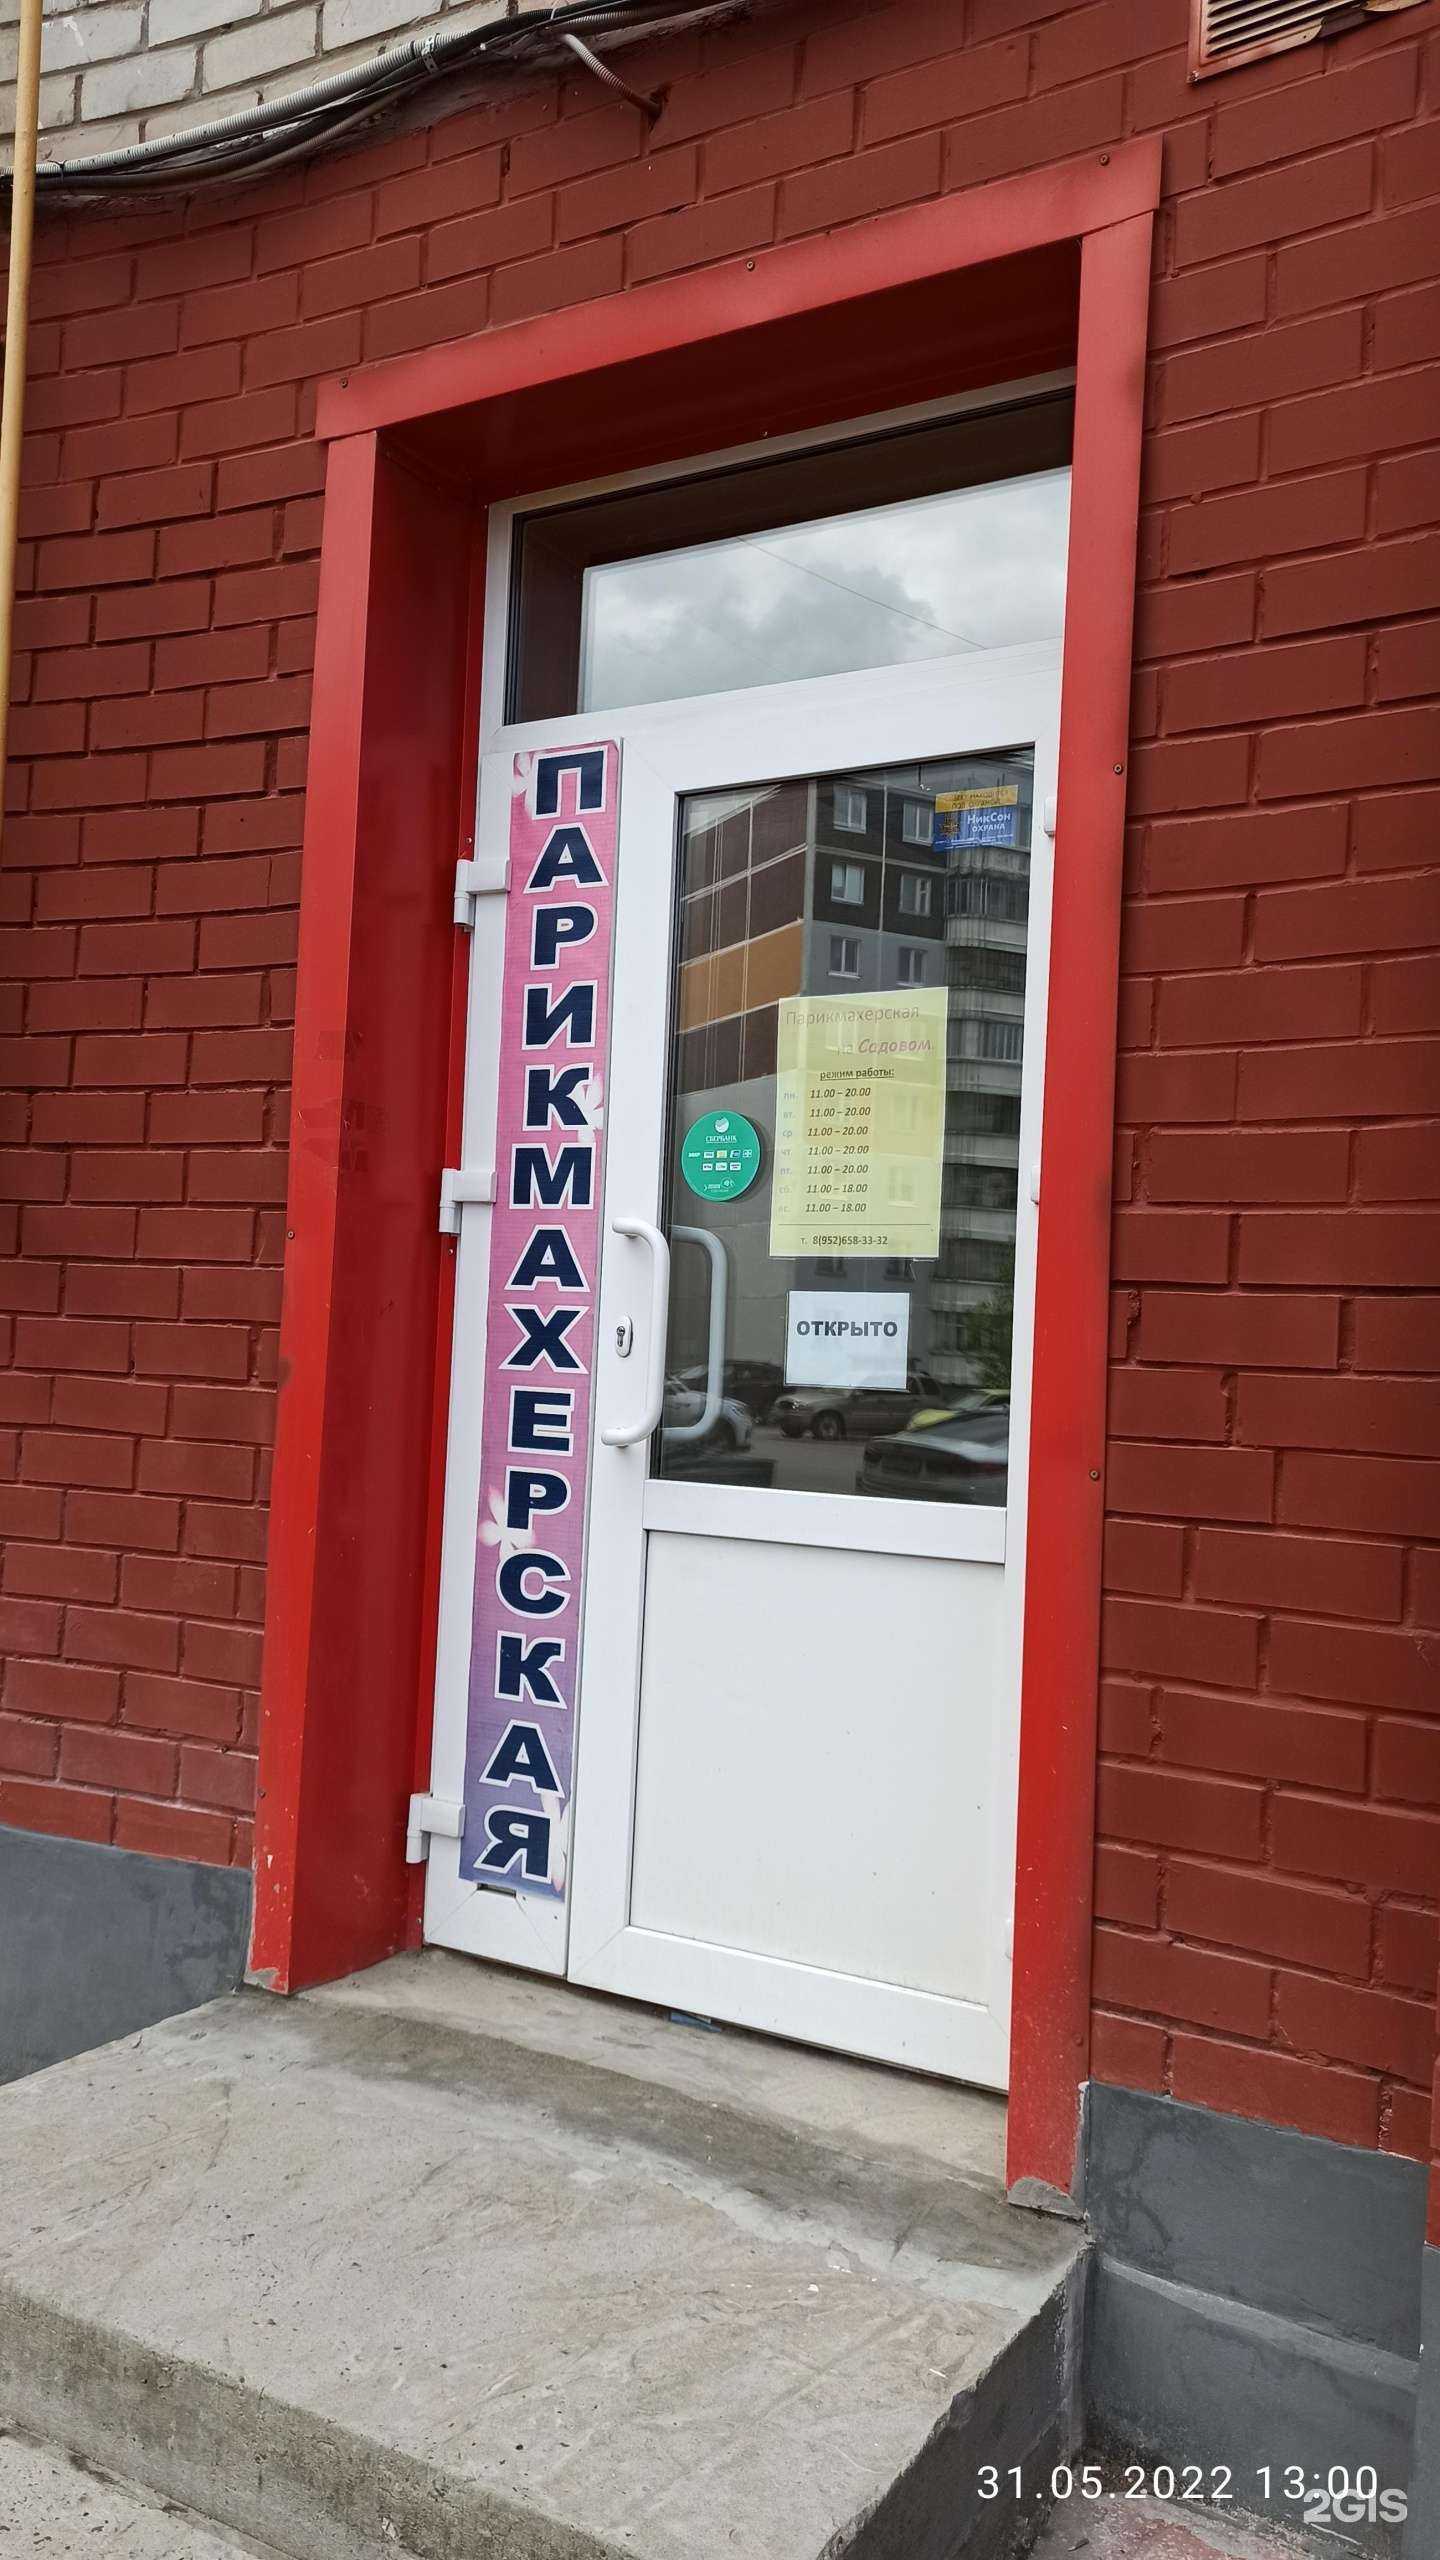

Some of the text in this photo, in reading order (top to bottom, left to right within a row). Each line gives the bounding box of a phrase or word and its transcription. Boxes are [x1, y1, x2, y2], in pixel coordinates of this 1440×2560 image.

[785, 1006, 920, 1027] Парикмахерская
[820, 1068, 895, 1081] режим работы:
[810, 1088, 836, 1099] 11.00
[844, 1087, 871, 1098] 20.00
[809, 1107, 836, 1118] 11.00
[844, 1106, 871, 1117] 20.00
[807, 1127, 833, 1137] 11.00
[842, 1126, 869, 1136] 20.00
[807, 1146, 833, 1156] 11.00
[842, 1145, 869, 1155] 20.00
[807, 1165, 833, 1175] 11.00
[842, 1164, 869, 1174] 20.00
[806, 1184, 832, 1194] 11.00
[842, 1183, 868, 1193] 18.00
[805, 1203, 831, 1213] 11.00
[840, 1202, 867, 1213] 18.00
[474, 746, 608, 1884] ПАРИКМАХЕРСКАЯ
[796, 1320, 898, 1337] ОТКРЫТО
